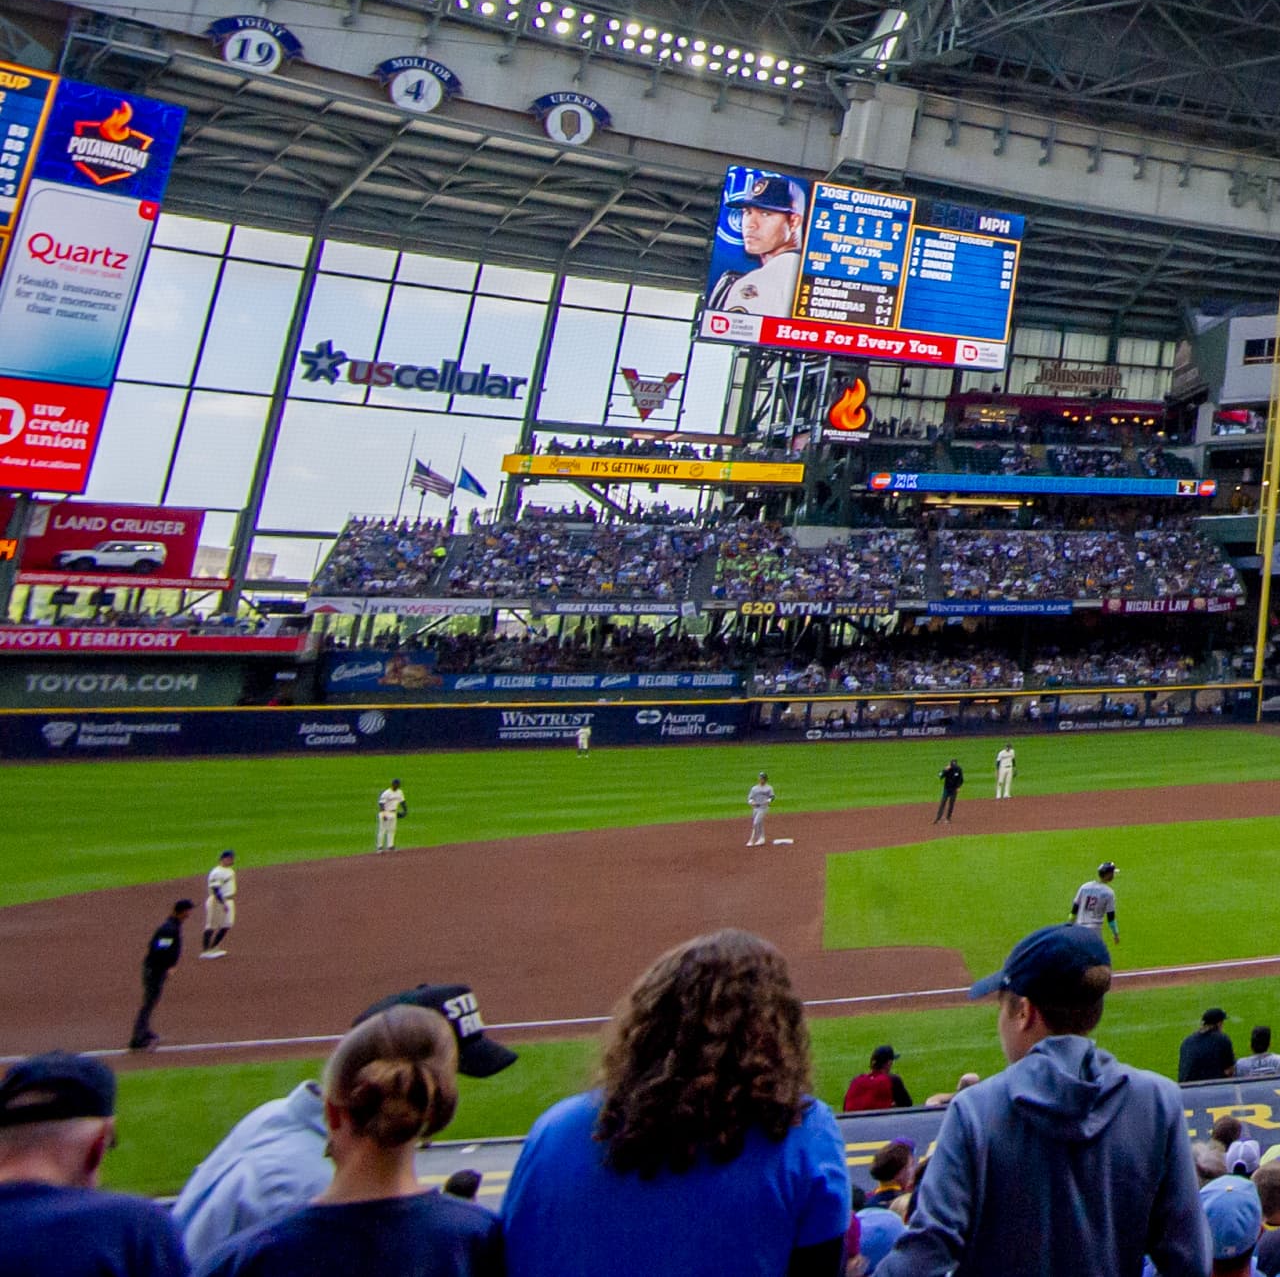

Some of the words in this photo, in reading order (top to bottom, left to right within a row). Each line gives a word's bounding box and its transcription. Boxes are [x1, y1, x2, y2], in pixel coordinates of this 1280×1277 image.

[236, 17, 286, 38] YOUNT
[235, 37, 275, 68] 19
[391, 57, 451, 82] MOLITOR
[403, 78, 427, 103] 4
[549, 94, 599, 111] UECKER
[67, 136, 149, 169] POTAWATOMI
[820, 186, 851, 201] JOSE
[851, 192, 909, 210] QUINTANA
[979, 216, 1011, 234] MPH
[27, 232, 131, 270] Quartz
[16, 273, 59, 290] Health
[62, 280, 123, 299] insurance
[776, 324, 819, 343] Here
[823, 331, 854, 347] For
[857, 334, 905, 355] Every
[908, 339, 943, 358] You.
[347, 359, 528, 400] uscellular
[1036, 361, 1123, 387] Johnsonville
[629, 380, 673, 395] VIZZY
[33, 404, 67, 417] uw
[28, 419, 90, 435] credit
[25, 434, 87, 450] union
[591, 462, 610, 473] IT'S
[611, 462, 650, 474] GETTING
[652, 464, 679, 475] JUICY
[53, 515, 107, 532] LAND
[110, 518, 187, 536] CRUISER
[556, 603, 590, 613] GREAT
[590, 603, 617, 612] TASTE.
[619, 603, 633, 612] 96
[634, 603, 679, 613] CALORIES.
[741, 602, 776, 614] 620
[780, 602, 833, 614] WTMJ
[929, 602, 982, 614] WINTRUST
[1125, 599, 1165, 613] NICOLET
[1168, 599, 1190, 612] LAW
[68, 631, 183, 647] TERRITORY
[26, 674, 199, 693] TOYOTA.COM
[494, 676, 536, 688] WELCOME
[551, 675, 597, 688] DELICIOUS
[638, 675, 679, 687] WELCOME
[692, 674, 733, 686] DELICIOUS
[500, 711, 595, 727] WINTRUST
[664, 713, 706, 724] Aurora
[299, 723, 350, 735] Johnson
[499, 730, 561, 740] WISCONSIN'S
[661, 724, 703, 737] Health
[706, 723, 735, 735] Care
[903, 727, 946, 737] BULLPEN
[305, 733, 357, 746] Controls
[1085, 896, 1098, 911] 12
